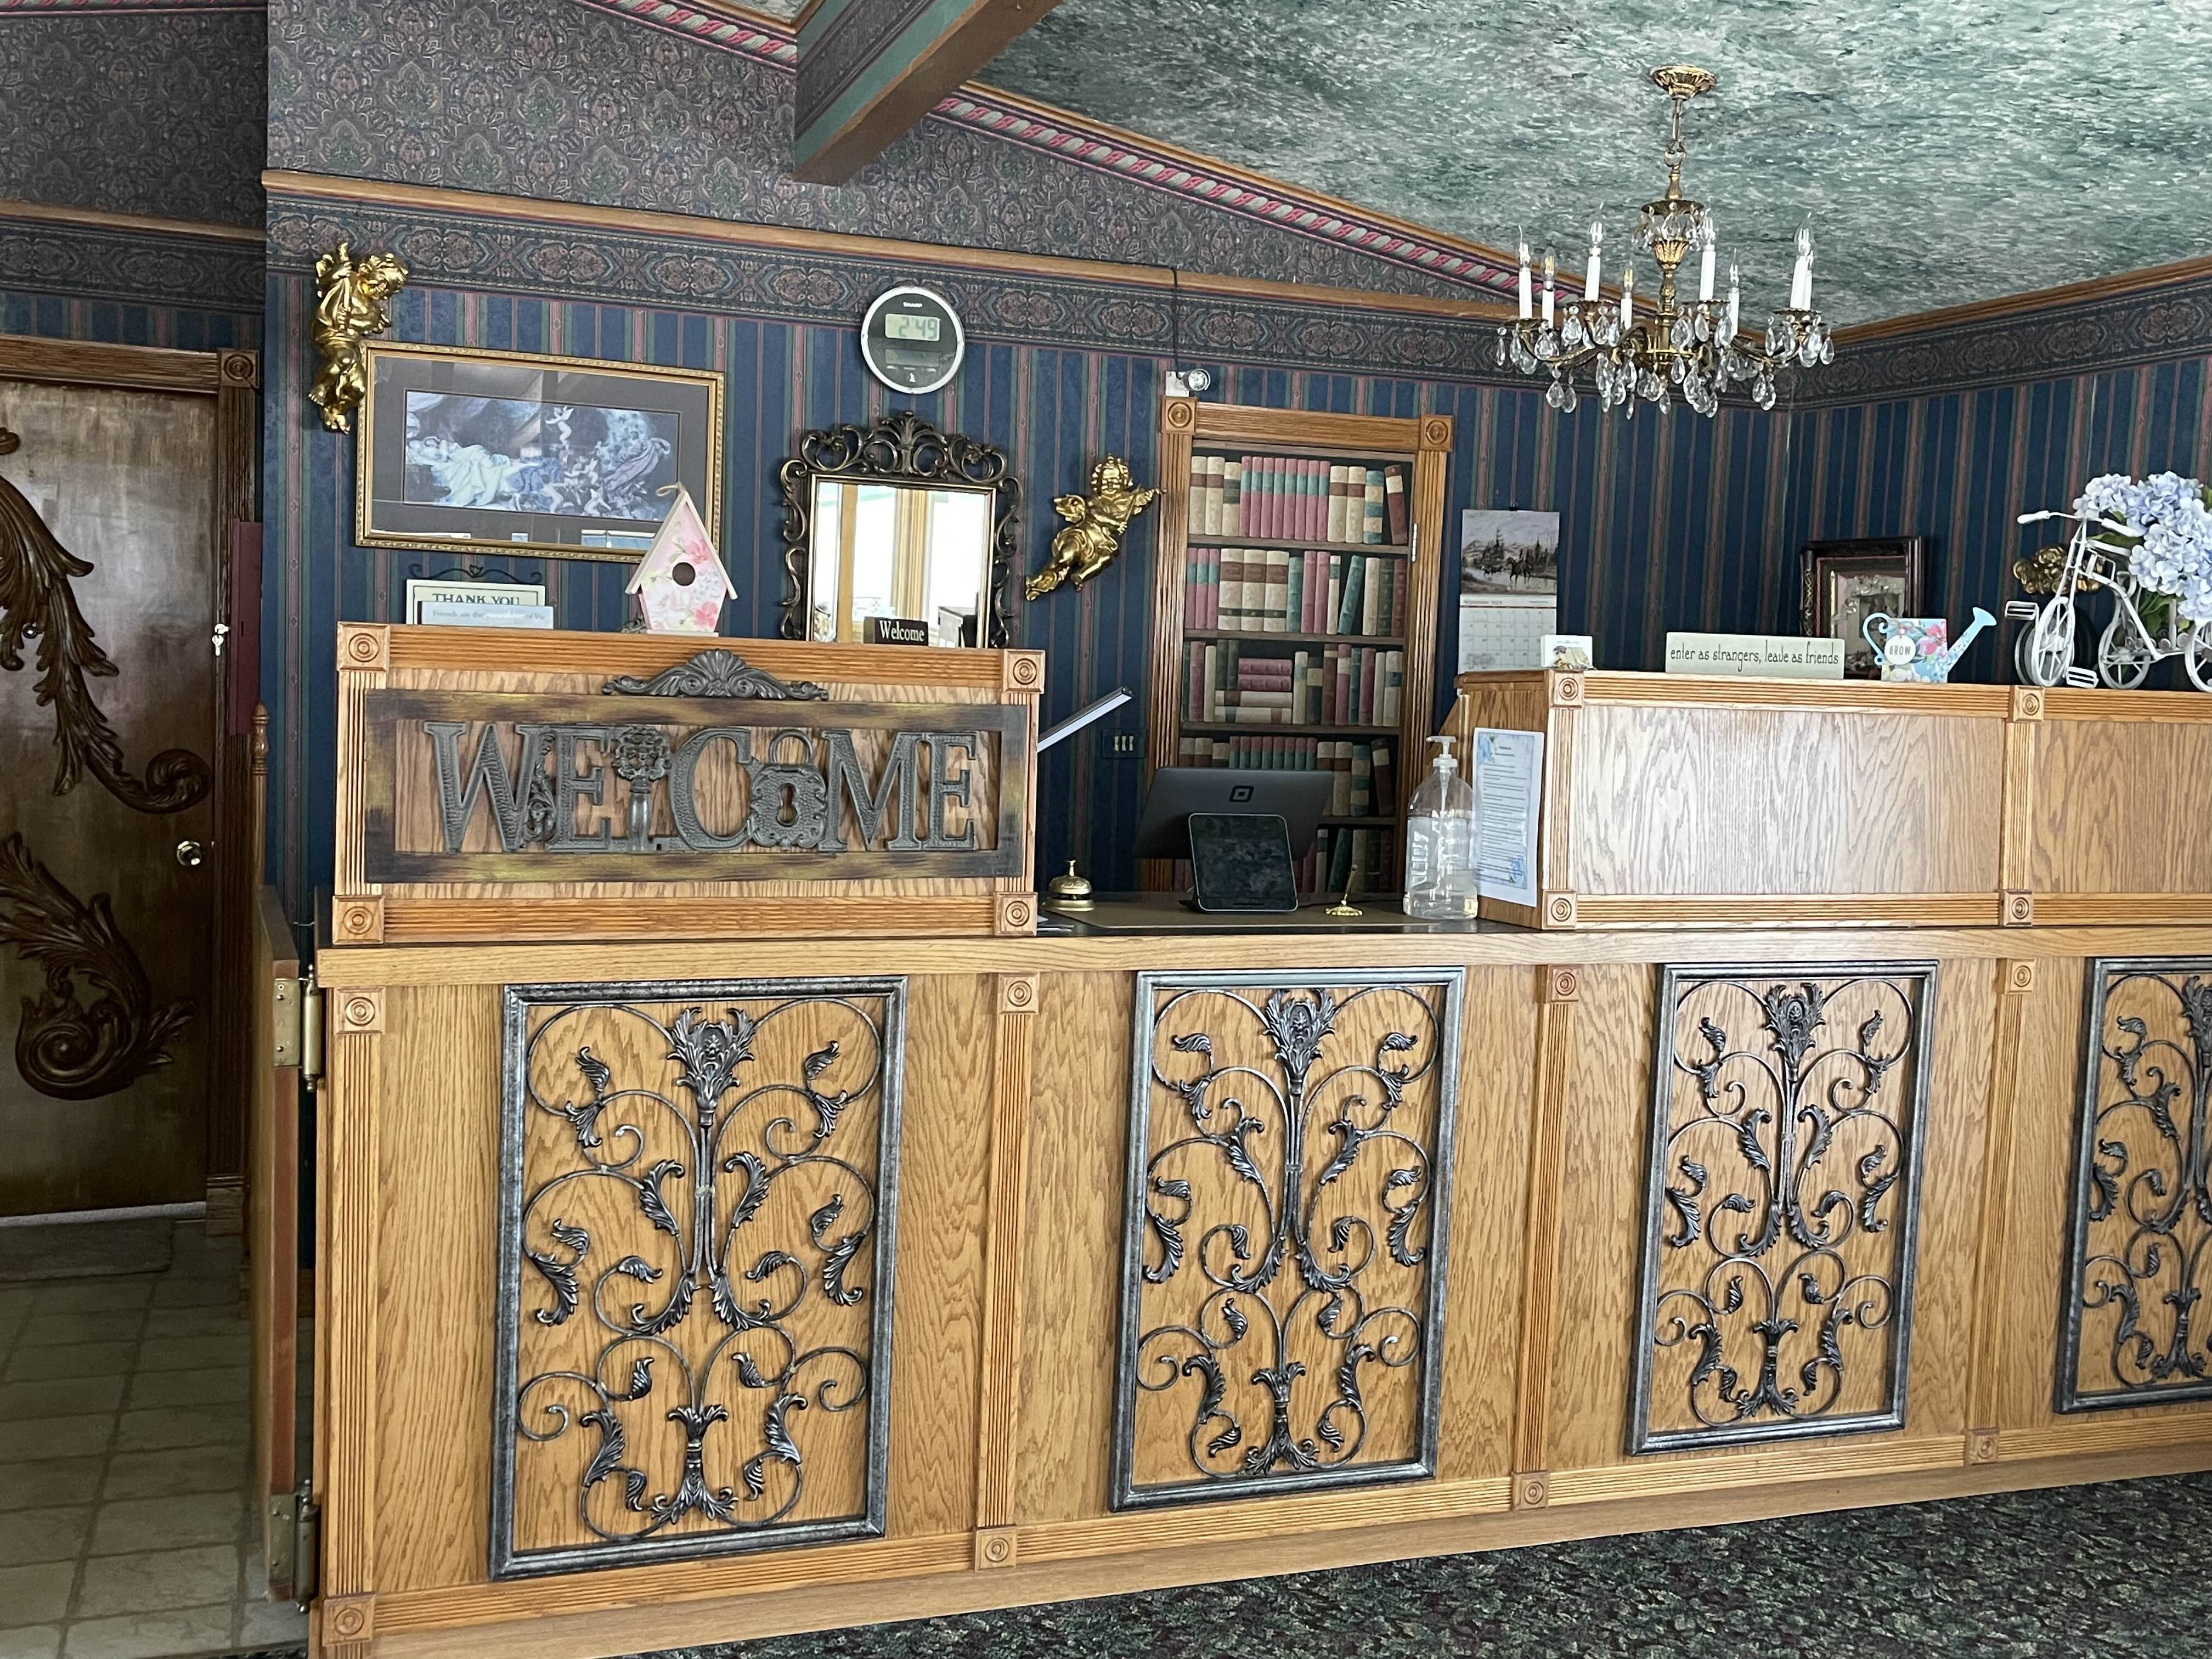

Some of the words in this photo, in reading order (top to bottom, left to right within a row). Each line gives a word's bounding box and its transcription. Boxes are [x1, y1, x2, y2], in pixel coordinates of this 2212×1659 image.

[432, 593, 486, 603] THANK
[492, 596, 520, 605] YOU
[879, 620, 925, 642] Welcome
[1671, 642, 1695, 661] enter
[1698, 650, 1710, 661] as
[1712, 644, 1762, 673] strangers,
[1765, 639, 1789, 663] leave
[1791, 653, 1803, 663] as
[1805, 640, 1838, 664] friends
[1889, 645, 1911, 656] GROW
[422, 720, 978, 853] WELCOME
